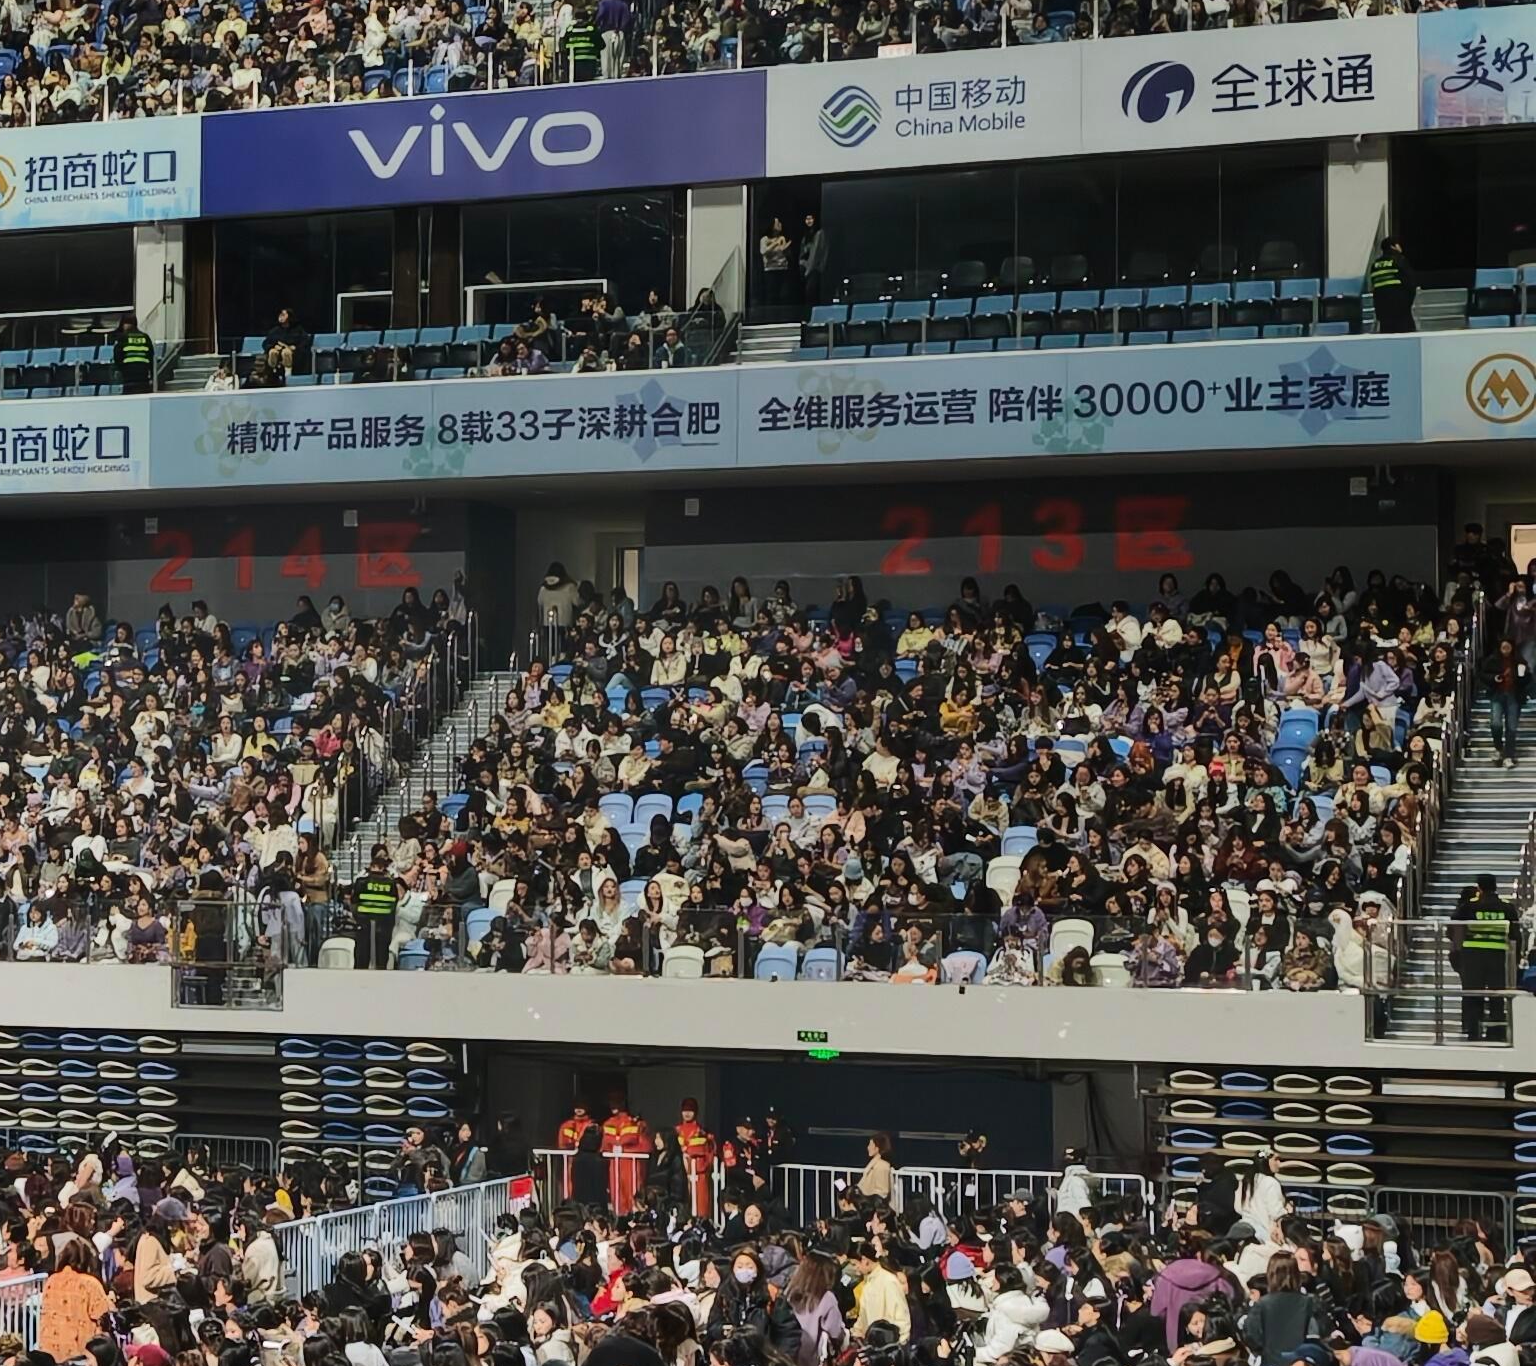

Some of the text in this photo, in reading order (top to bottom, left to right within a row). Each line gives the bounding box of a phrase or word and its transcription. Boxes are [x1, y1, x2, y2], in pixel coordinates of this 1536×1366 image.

[1211, 53, 1375, 113] 全球通
[1441, 34, 1536, 93] 美好
[896, 75, 1025, 114] 中国移动
[348, 103, 604, 179] vivo
[896, 111, 1025, 137] China Mobile
[24, 150, 176, 192] 招商蛇口
[227, 401, 721, 455] 精研产品服务 8载33子深耕合肥
[758, 388, 977, 432] 全维服务运营
[988, 384, 1065, 425] 陪伴
[149, 522, 423, 593] 214区
[880, 494, 1195, 576] 213区
